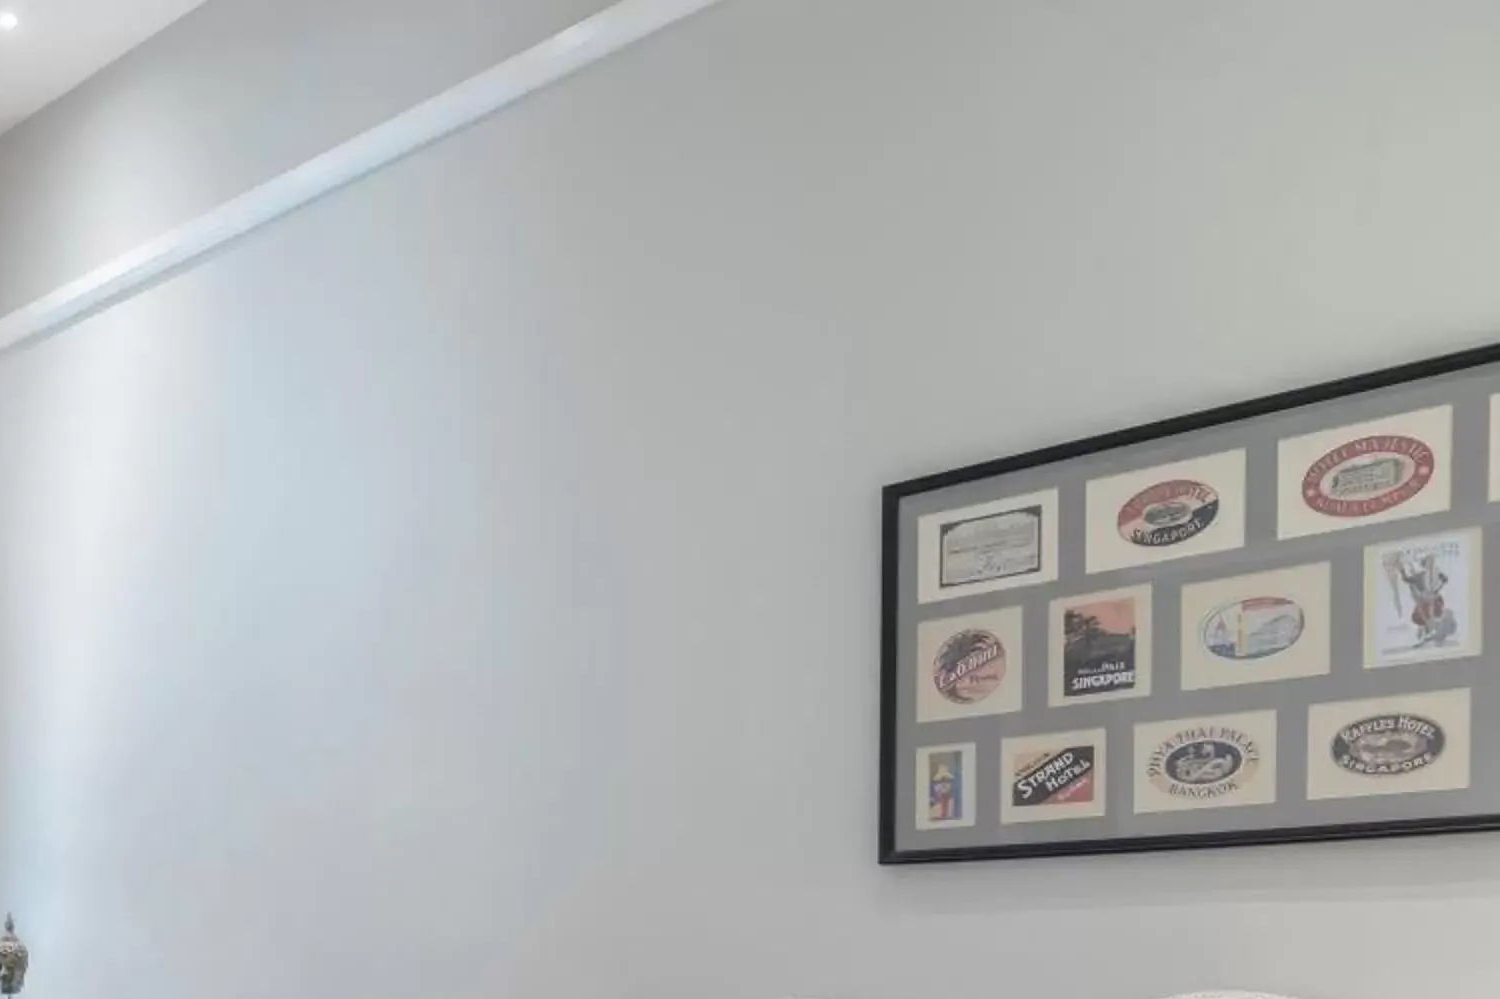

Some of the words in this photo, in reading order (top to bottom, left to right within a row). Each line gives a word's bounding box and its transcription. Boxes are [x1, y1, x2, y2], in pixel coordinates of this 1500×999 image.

[1071, 670, 1136, 691] SINGAPORE
[1340, 720, 1396, 742] RAFFLES
[1399, 716, 1436, 738] HOTEL
[1017, 751, 1074, 800] STRAND
[1045, 759, 1091, 791] HOTEL
[1169, 780, 1238, 800] BANGKOK
